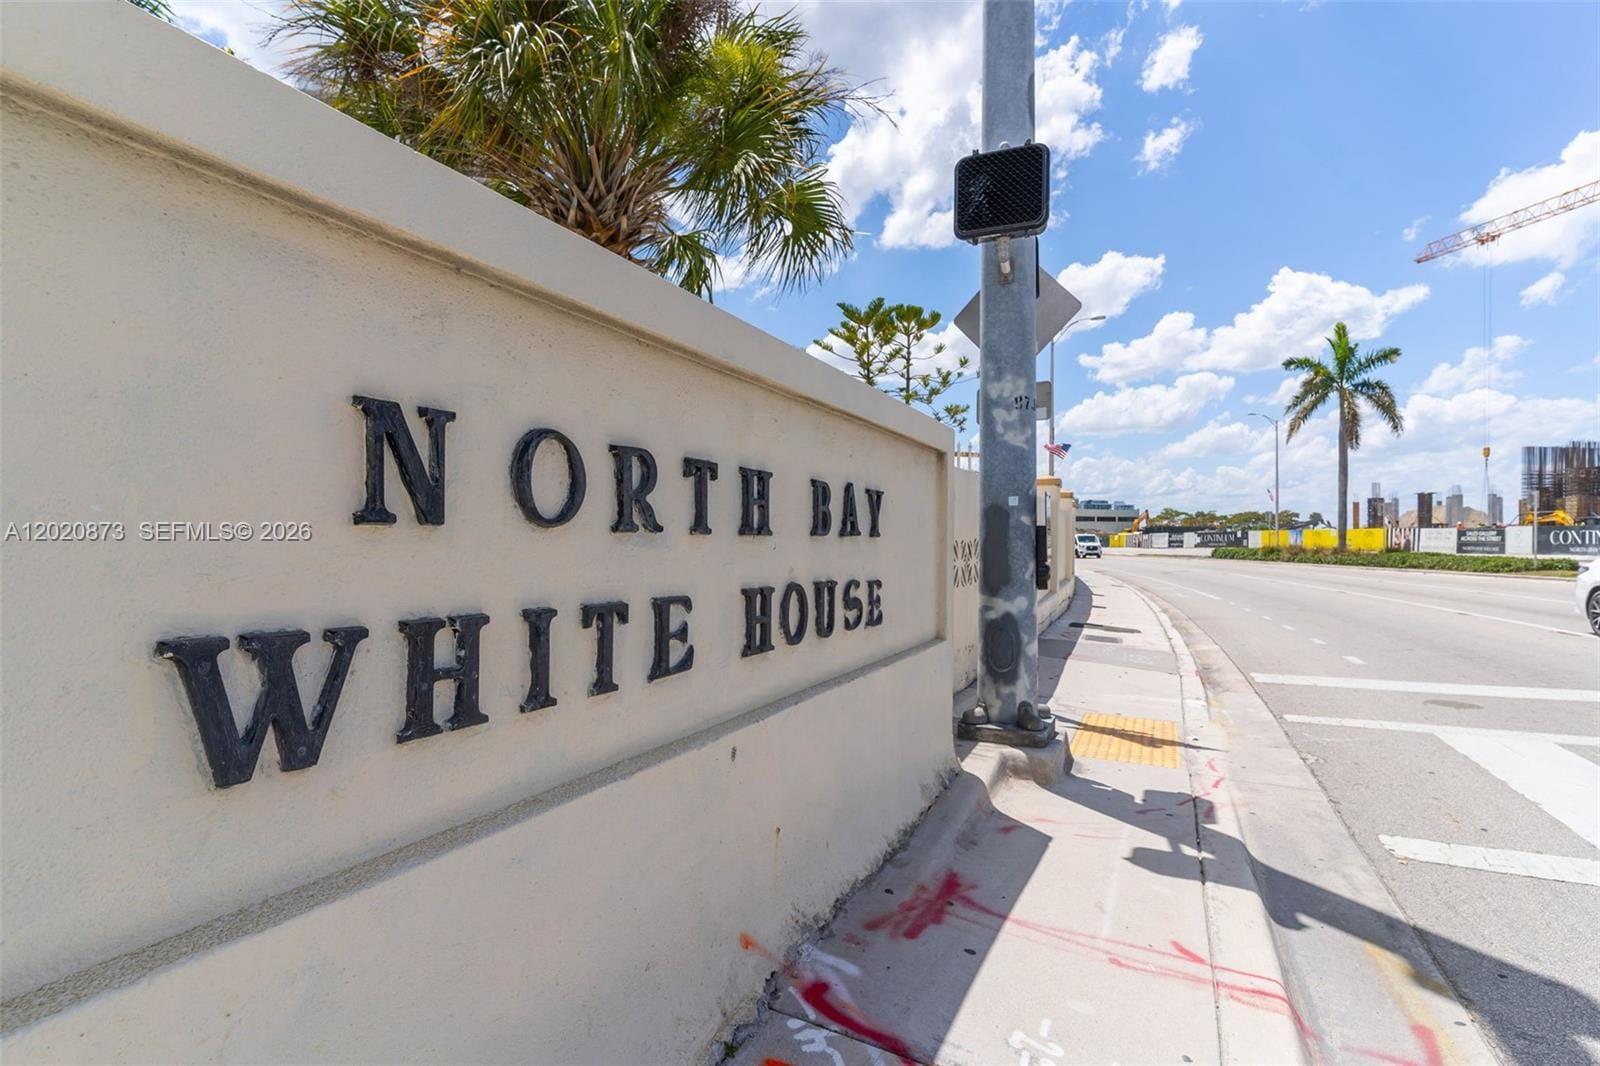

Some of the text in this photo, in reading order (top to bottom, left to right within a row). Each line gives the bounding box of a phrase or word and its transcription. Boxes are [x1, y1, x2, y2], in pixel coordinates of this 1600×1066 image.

[352, 395, 885, 538] NORTH BAY
[154, 579, 884, 788] WHITE HOUSE
